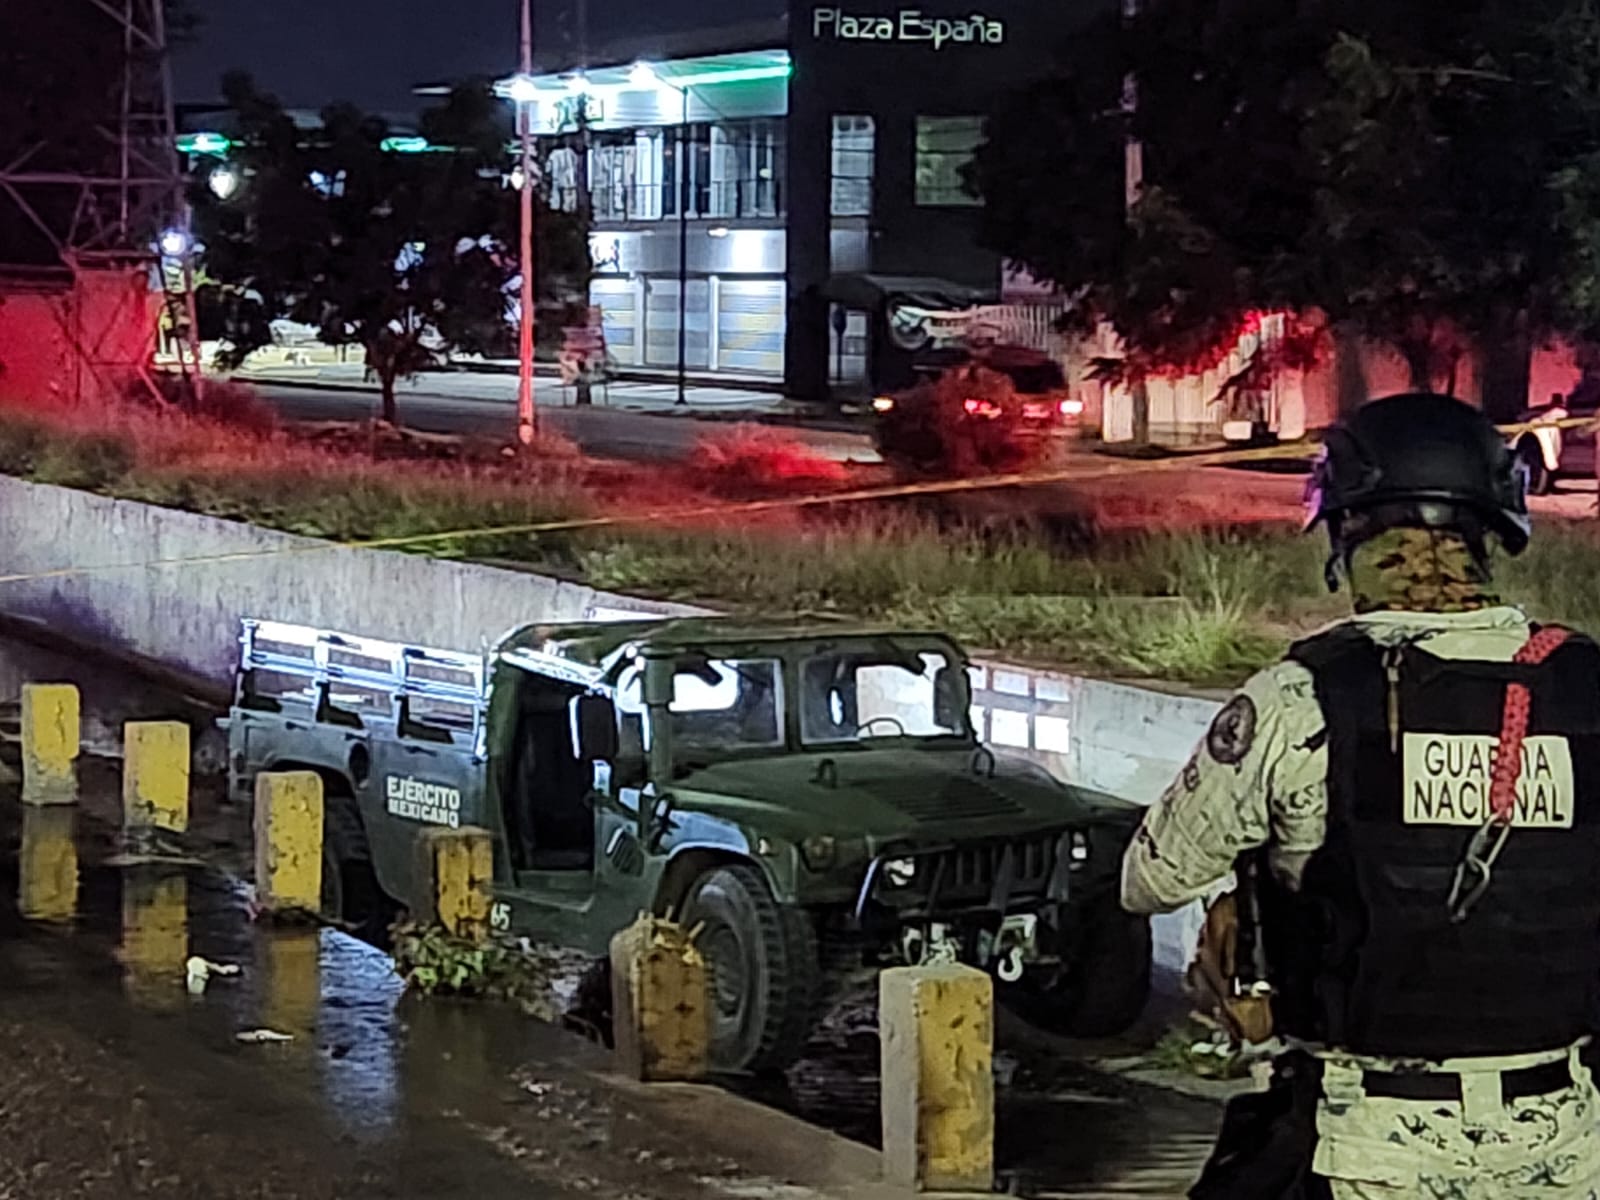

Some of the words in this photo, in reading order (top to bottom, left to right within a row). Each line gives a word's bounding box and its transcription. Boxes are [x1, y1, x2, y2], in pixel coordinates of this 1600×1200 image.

[813, 8, 893, 39] Plaza
[898, 10, 1003, 50] España
[1425, 740, 1552, 780] GUARIA
[387, 775, 461, 810] EJÉRCITO
[1414, 780, 1565, 822] NACINAL
[387, 798, 460, 829] MEXICANO
